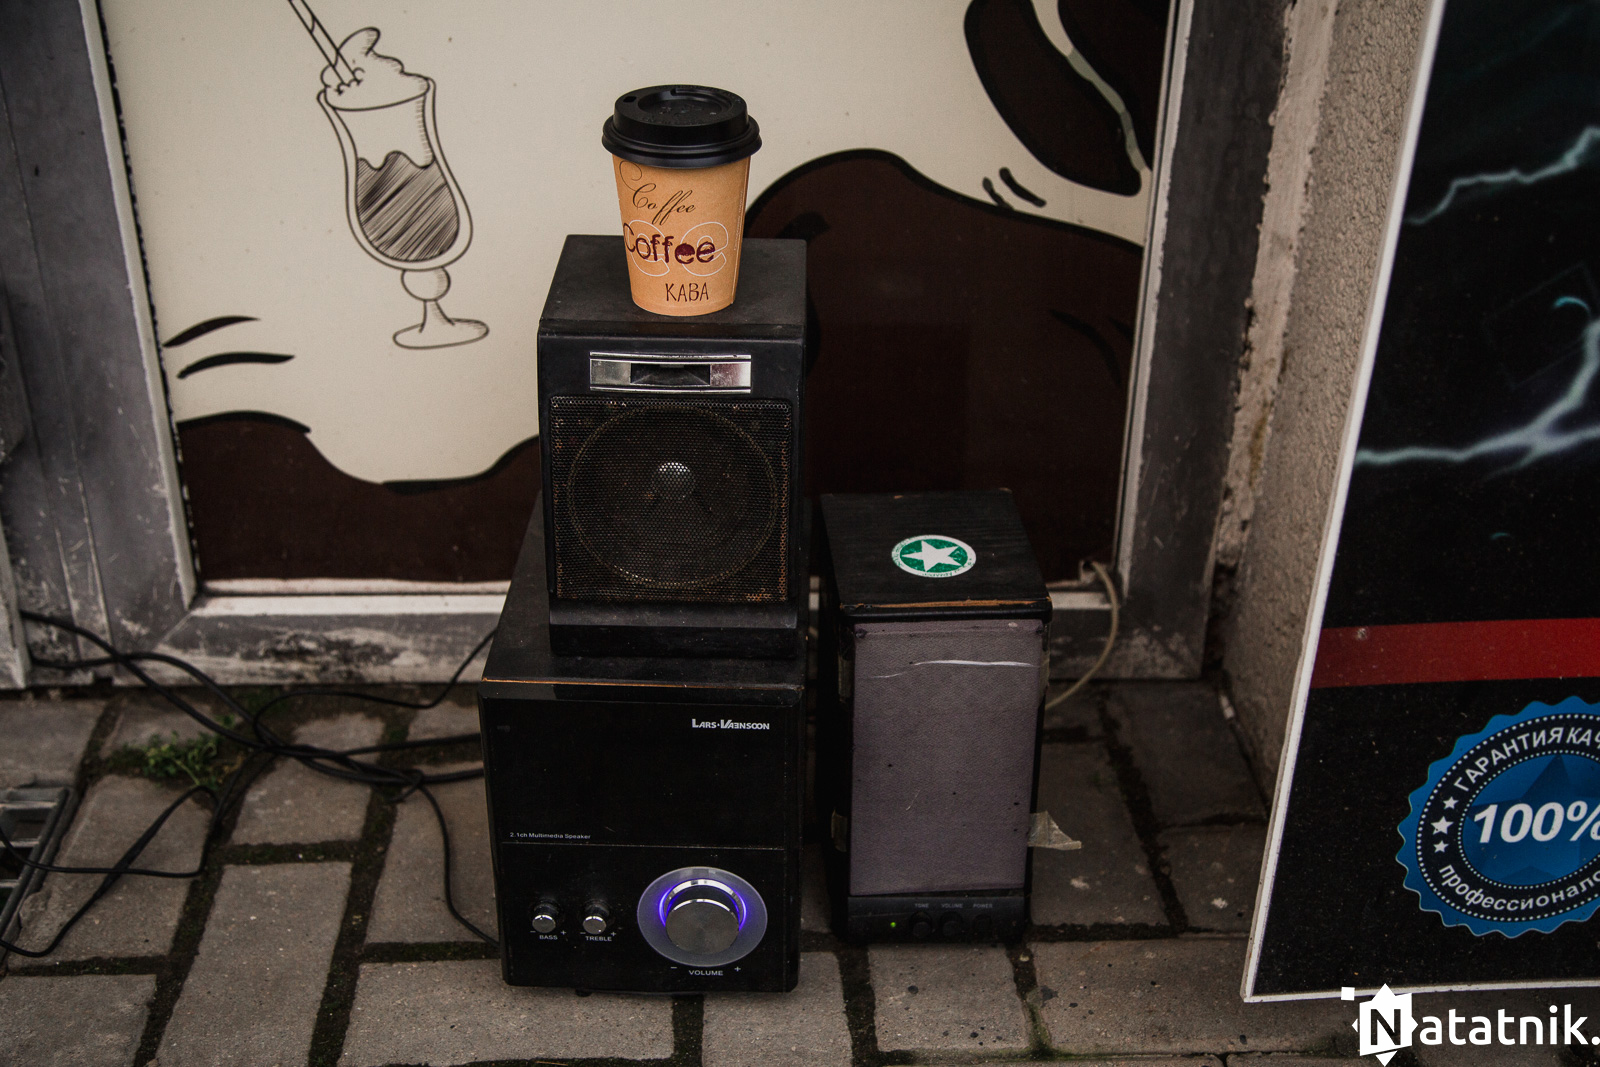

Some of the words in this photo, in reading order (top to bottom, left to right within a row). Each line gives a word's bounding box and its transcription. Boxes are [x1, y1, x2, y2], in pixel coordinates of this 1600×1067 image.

[619, 160, 696, 226] Coffee
[623, 222, 716, 265] Coffee
[1454, 727, 1564, 792] ГАРАНТИЯ
[564, 833, 591, 841] Speaker
[1474, 800, 1600, 843] 100%
